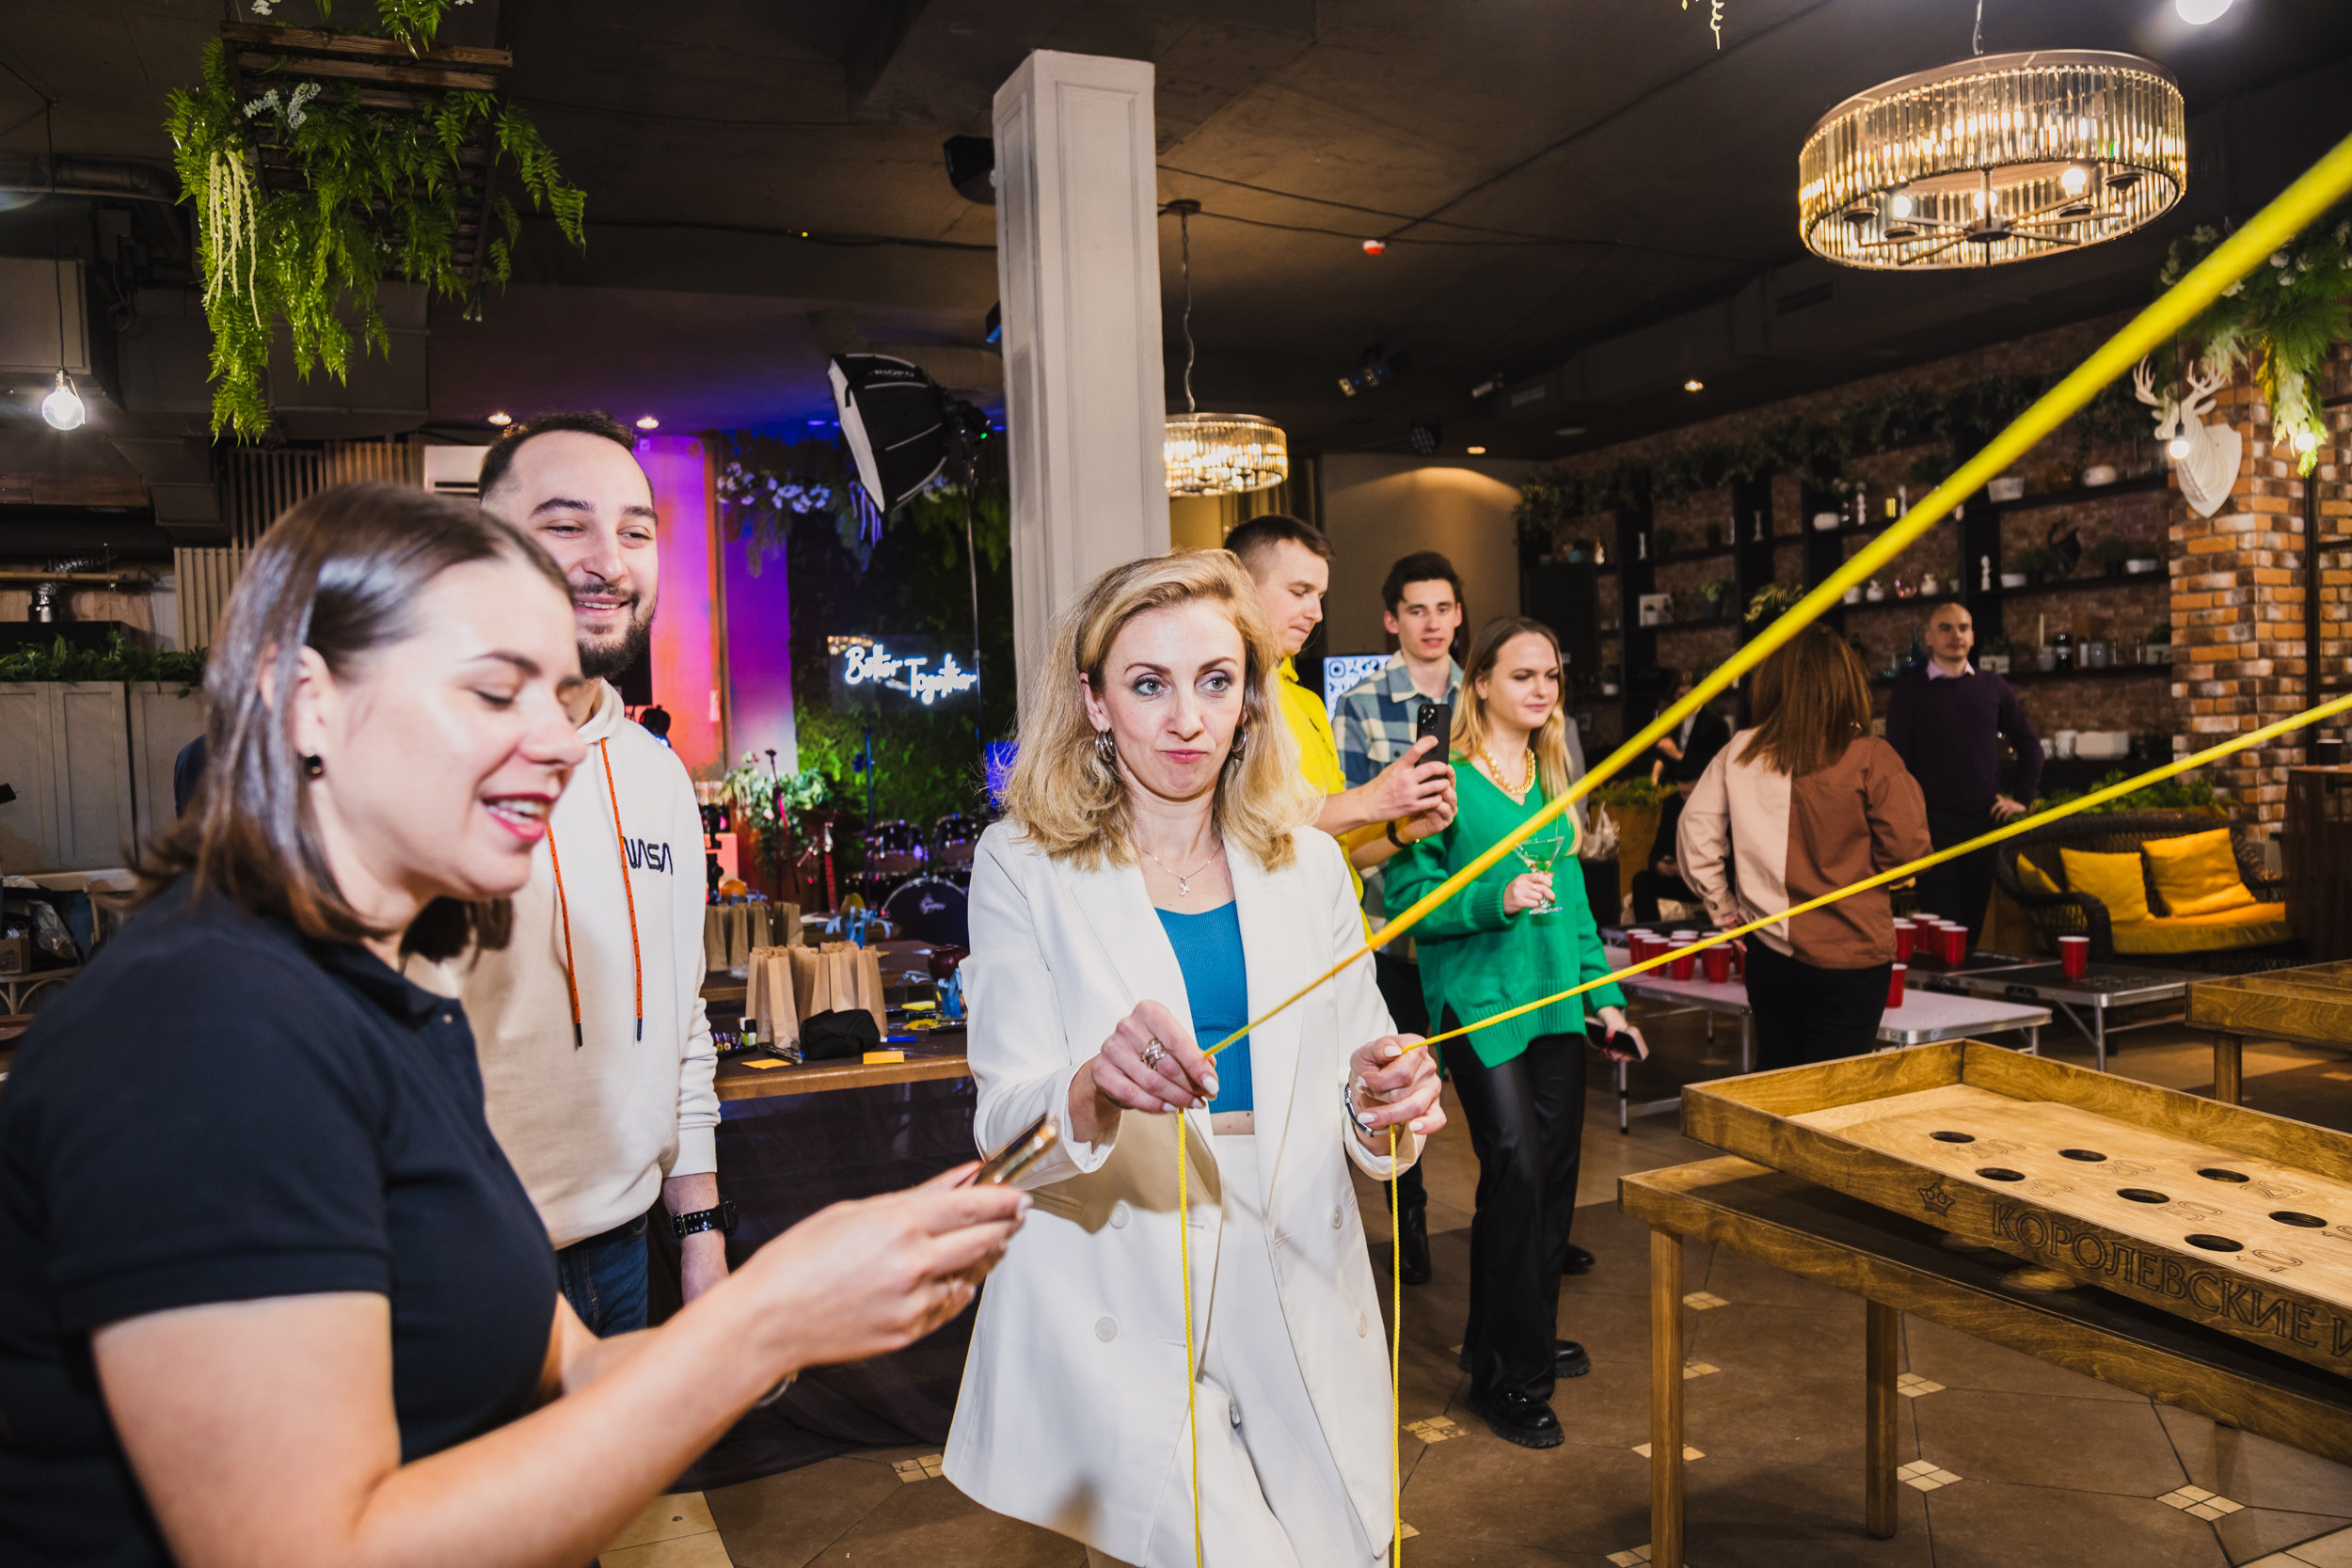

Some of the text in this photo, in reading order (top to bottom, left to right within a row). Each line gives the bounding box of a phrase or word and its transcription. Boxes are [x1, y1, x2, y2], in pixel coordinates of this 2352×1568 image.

[845, 643, 902, 685] Better
[2157, 1200, 2223, 1221] 50
[1992, 1201, 2318, 1349] КОРОЛЕВСКИЕ
[2236, 1249, 2303, 1273] 10
